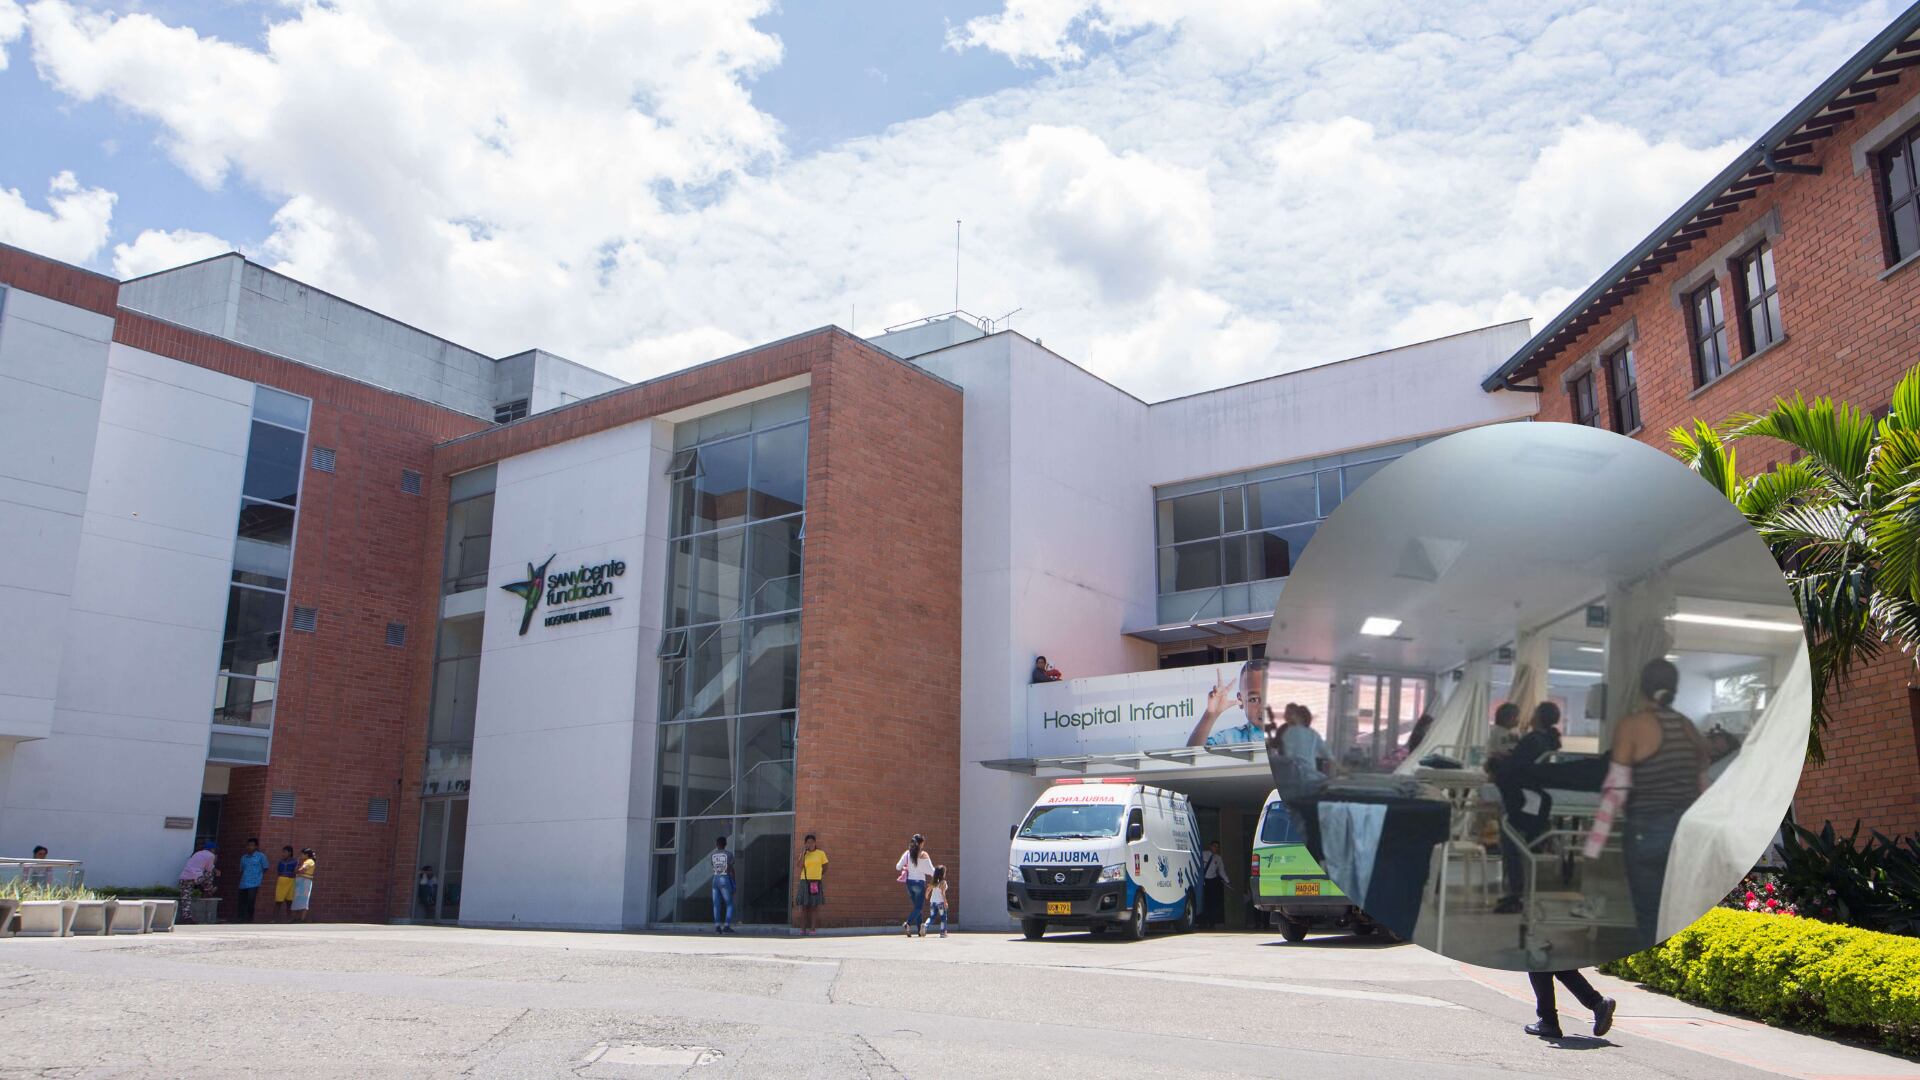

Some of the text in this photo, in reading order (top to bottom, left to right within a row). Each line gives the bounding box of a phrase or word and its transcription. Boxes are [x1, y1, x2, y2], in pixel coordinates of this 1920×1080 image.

[546, 580, 613, 606] fundación
[544, 606, 612, 627] HOSPITAL INFANTIL
[1043, 698, 1194, 730] Hospital Infantil
